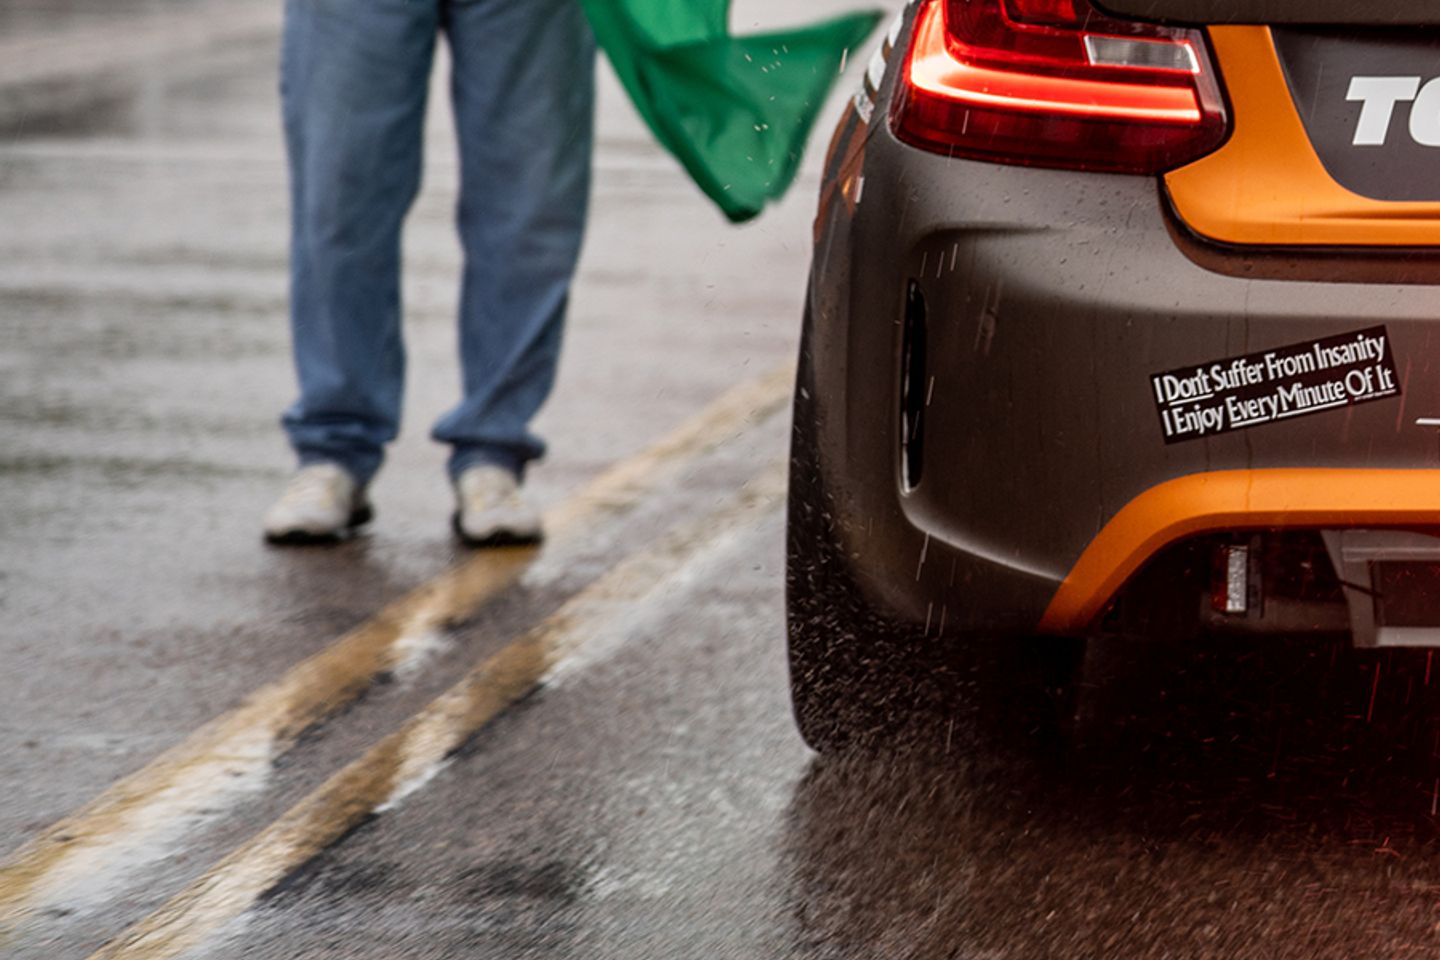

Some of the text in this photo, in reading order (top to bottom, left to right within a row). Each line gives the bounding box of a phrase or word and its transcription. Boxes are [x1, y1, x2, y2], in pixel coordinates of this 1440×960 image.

[1211, 358, 1265, 392] Suffer
[1265, 352, 1316, 381] From
[1314, 334, 1386, 371] Insanity
[1173, 403, 1225, 435] Enjoy
[1225, 394, 1280, 422] Every
[1278, 383, 1346, 413] Minute
[1345, 369, 1373, 398] Of
[1377, 365, 1396, 392] It
